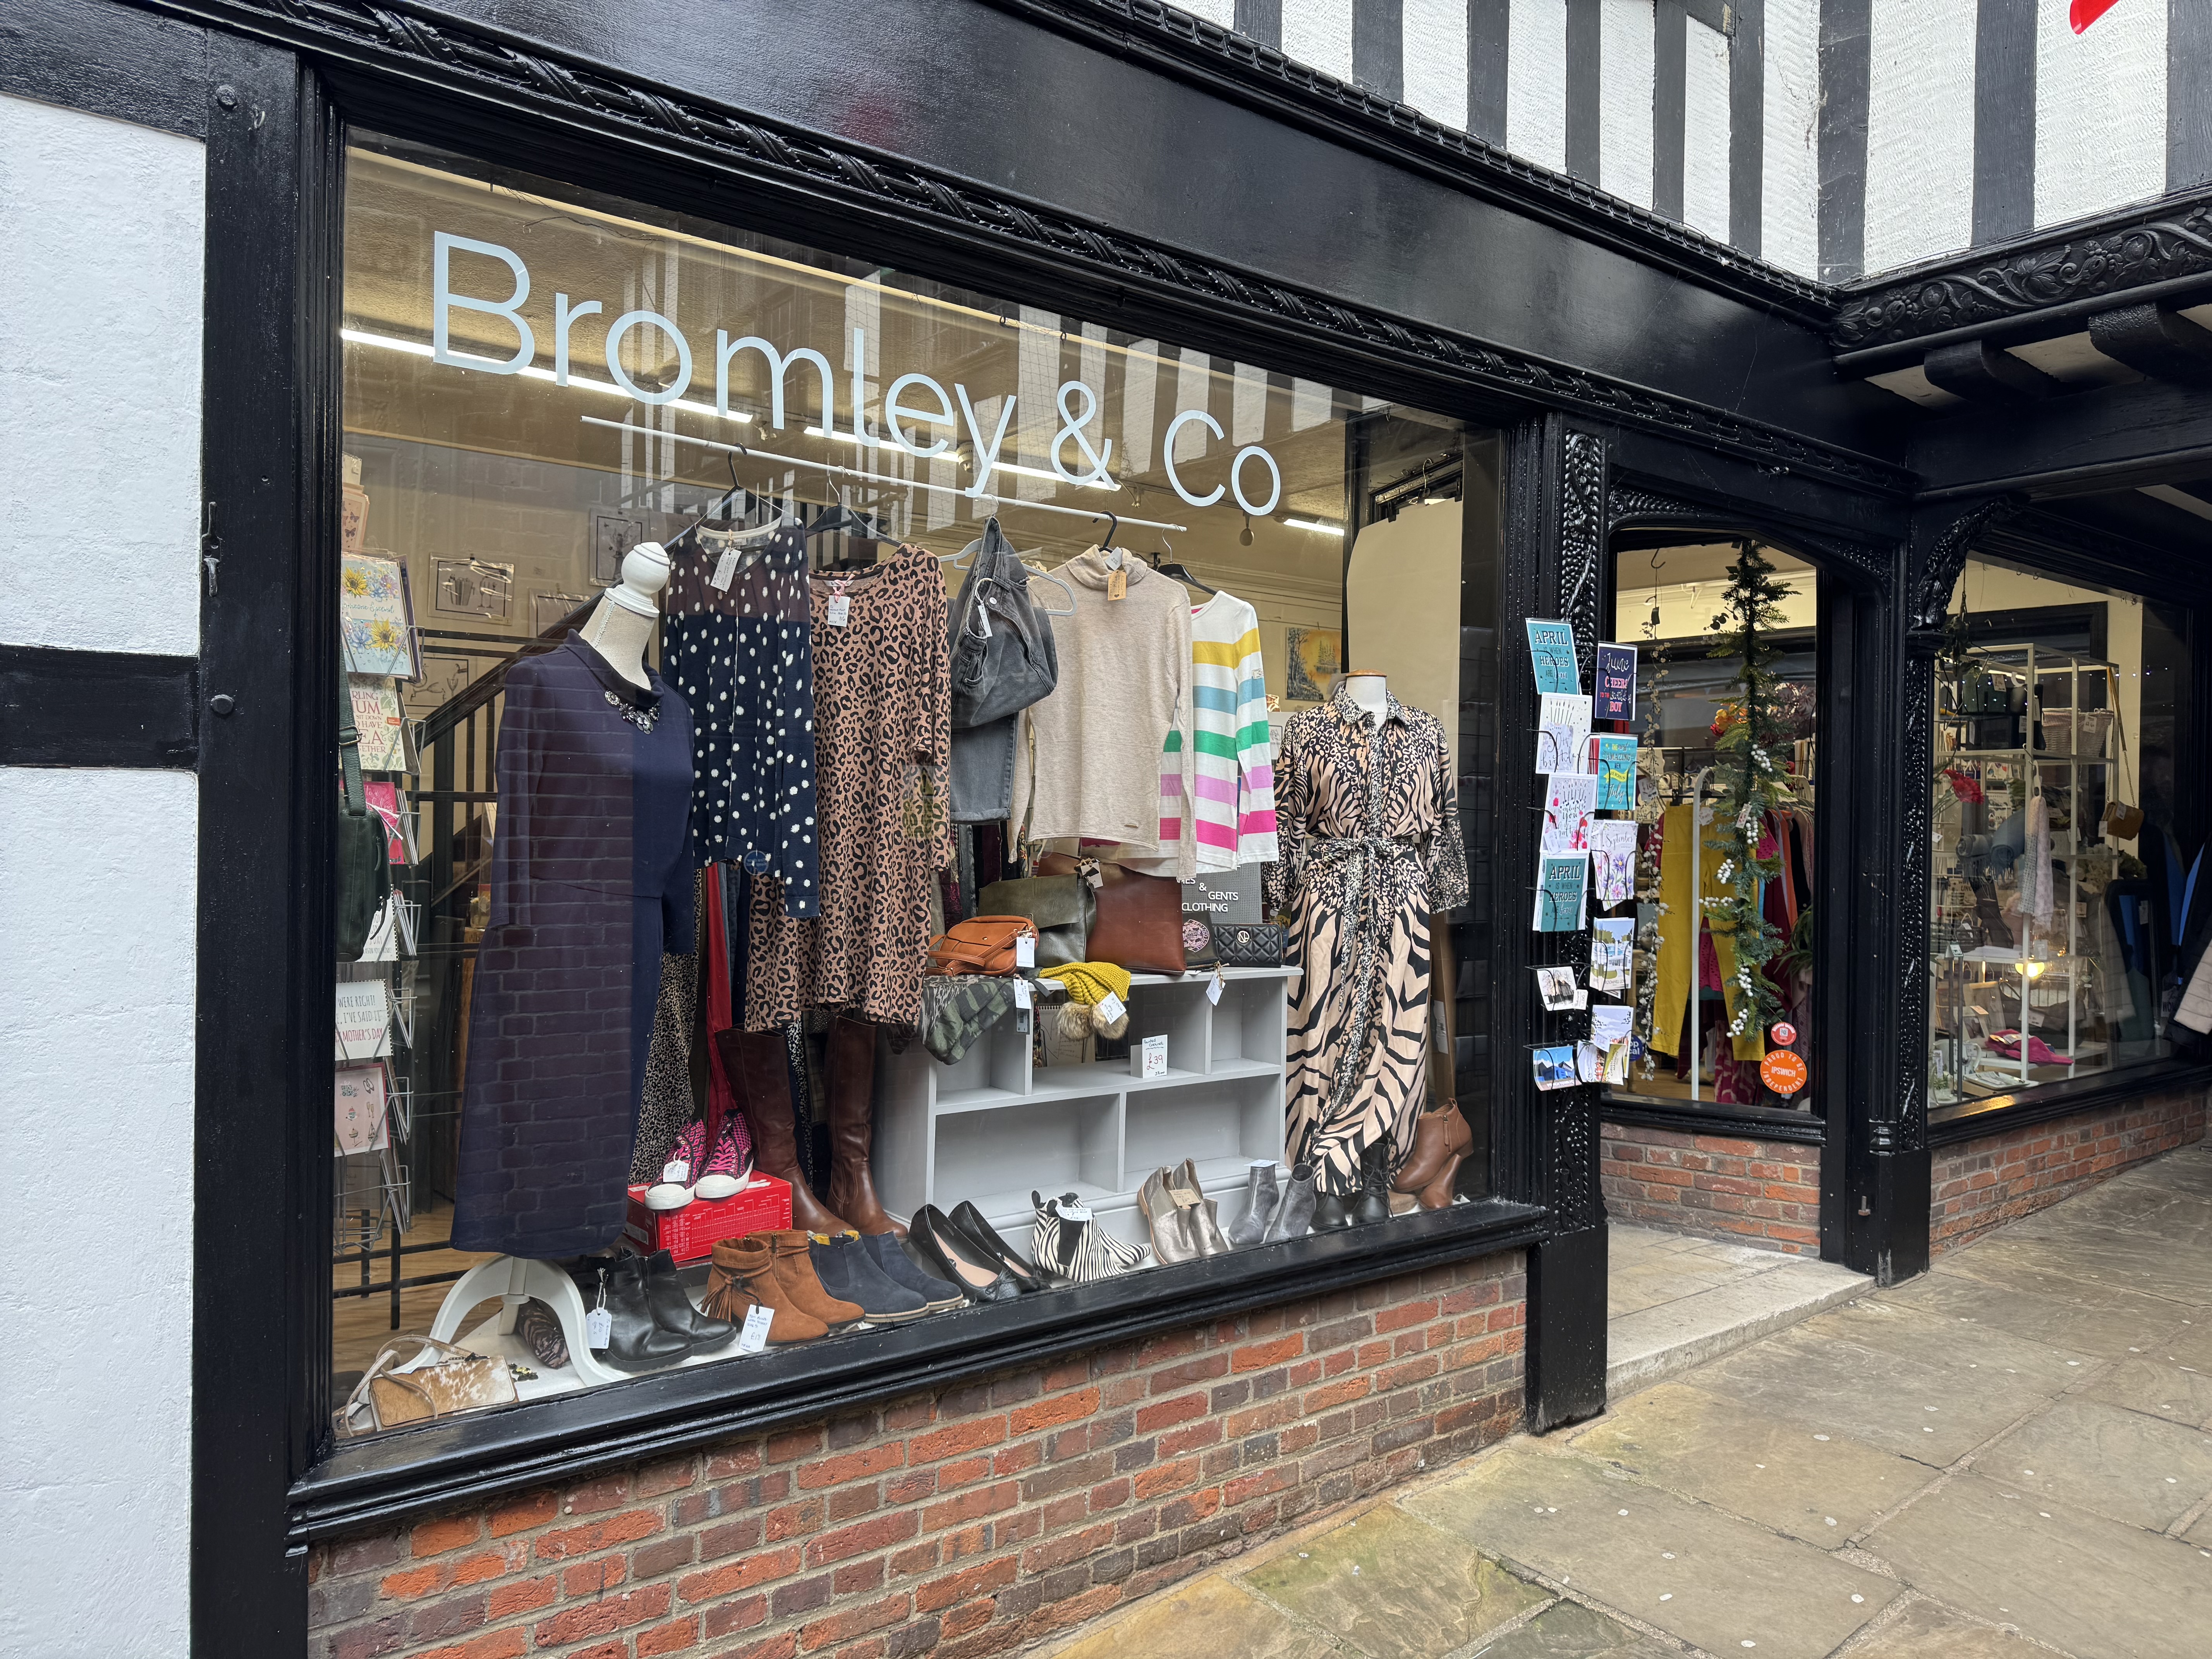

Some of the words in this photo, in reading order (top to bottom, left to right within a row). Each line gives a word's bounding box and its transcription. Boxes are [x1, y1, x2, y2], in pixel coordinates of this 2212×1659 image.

[434, 232, 1015, 497] Bromley
[1052, 381, 1121, 492] &
[1164, 410, 1280, 515] Co
[1535, 630, 1569, 646] APRIL
[1540, 656, 1570, 667] HEROES
[1606, 653, 1630, 673] June
[352, 690, 378, 700] RLING
[1609, 701, 1623, 712] BOY
[362, 721, 383, 729] HAVE
[1606, 753, 1631, 762] AMAZING
[1608, 781, 1626, 804] July
[1606, 832, 1633, 850] September
[1549, 866, 1581, 880] APRIL
[1199, 882, 1207, 891] &
[1208, 891, 1239, 901] GENTS
[1549, 891, 1577, 902] HEROES
[1182, 902, 1228, 912] CLOTHING
[338, 996, 354, 1008] WERE
[355, 995, 375, 1007] RIGHT!
[343, 1012, 356, 1023] I'VE
[357, 1011, 372, 1022] SAID
[374, 1010, 382, 1022] IT
[342, 1029, 371, 1042] MOTHER'S
[371, 1028, 382, 1039] DAY
[1764, 1052, 1784, 1066] PROUD
[1788, 1053, 1797, 1062] TO
[1796, 1063, 1805, 1072] BE
[1771, 1066, 1796, 1078] IPSWICH
[1762, 1071, 1804, 1092] INDEPENDENT
